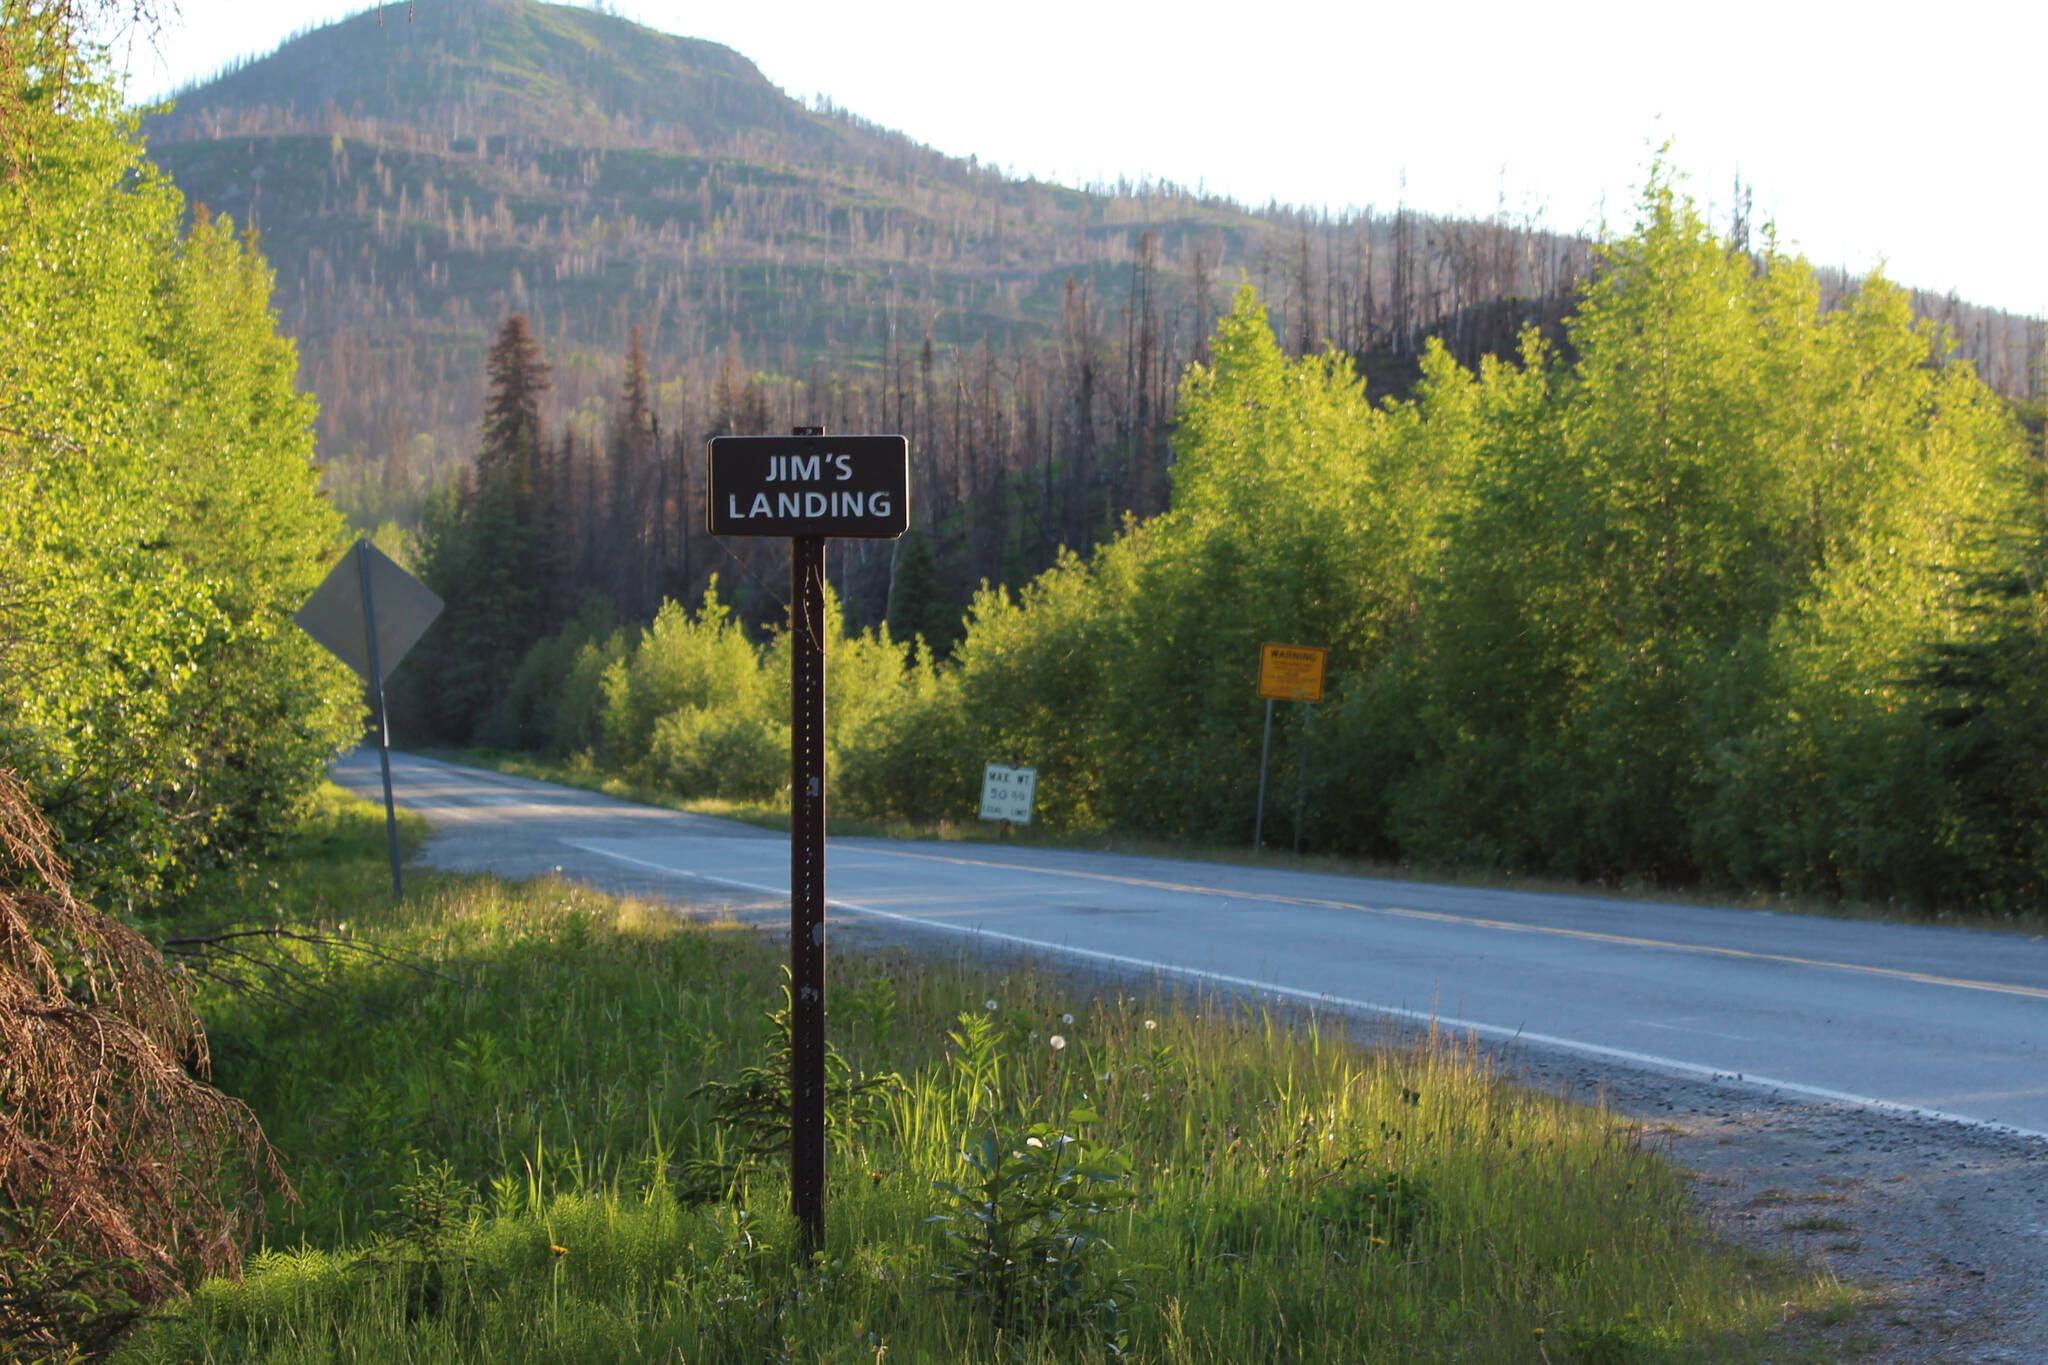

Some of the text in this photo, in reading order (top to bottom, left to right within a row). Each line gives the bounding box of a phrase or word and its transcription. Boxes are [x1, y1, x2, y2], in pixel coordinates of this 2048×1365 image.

[765, 453, 853, 482] JIM'S
[729, 491, 892, 519] LANDING
[1271, 649, 1317, 663] WARNING
